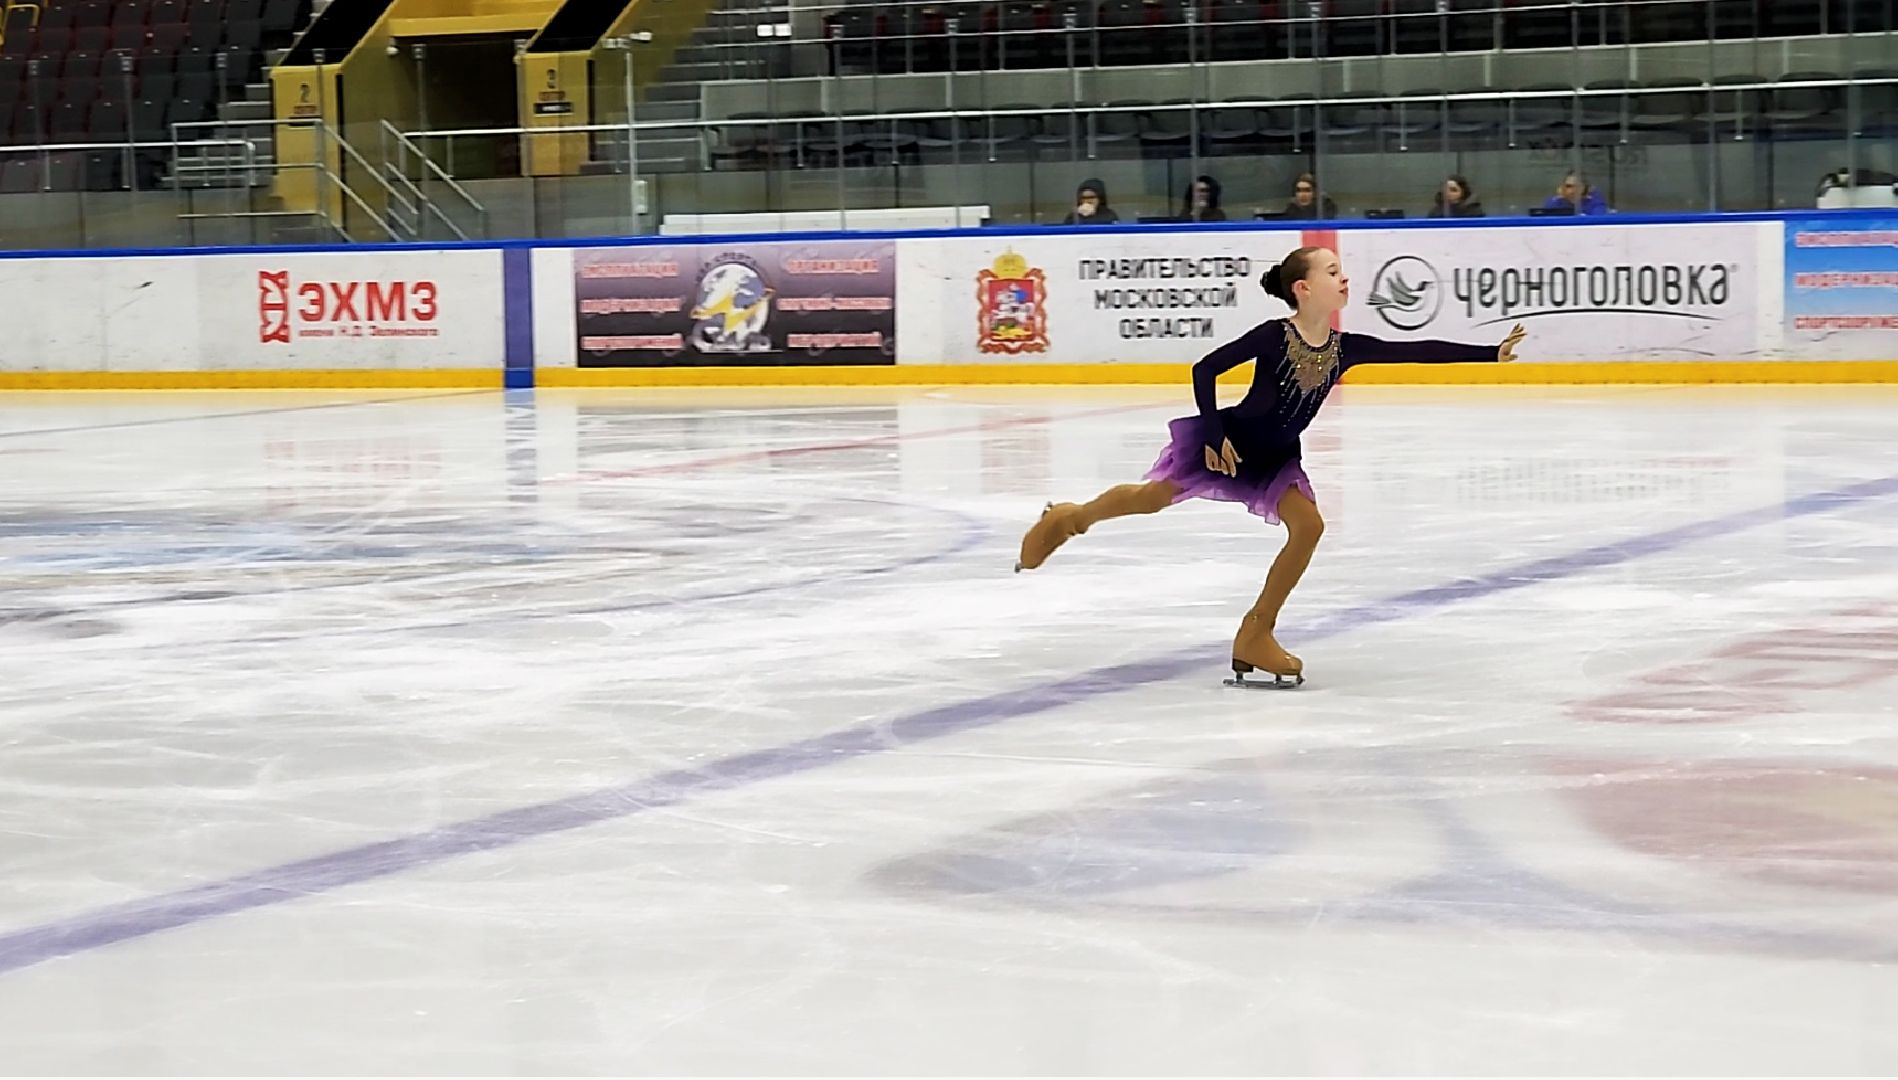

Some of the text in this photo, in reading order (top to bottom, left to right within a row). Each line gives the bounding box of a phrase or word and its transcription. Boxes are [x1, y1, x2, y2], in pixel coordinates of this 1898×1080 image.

[1079, 257, 1250, 279] ПРАВИТЕЛЬСТВО
[299, 282, 438, 321] ЭХМЗ
[1094, 281, 1237, 308] МОСКОВСКОЙ
[1119, 318, 1213, 338] ОБЛАСТИ
